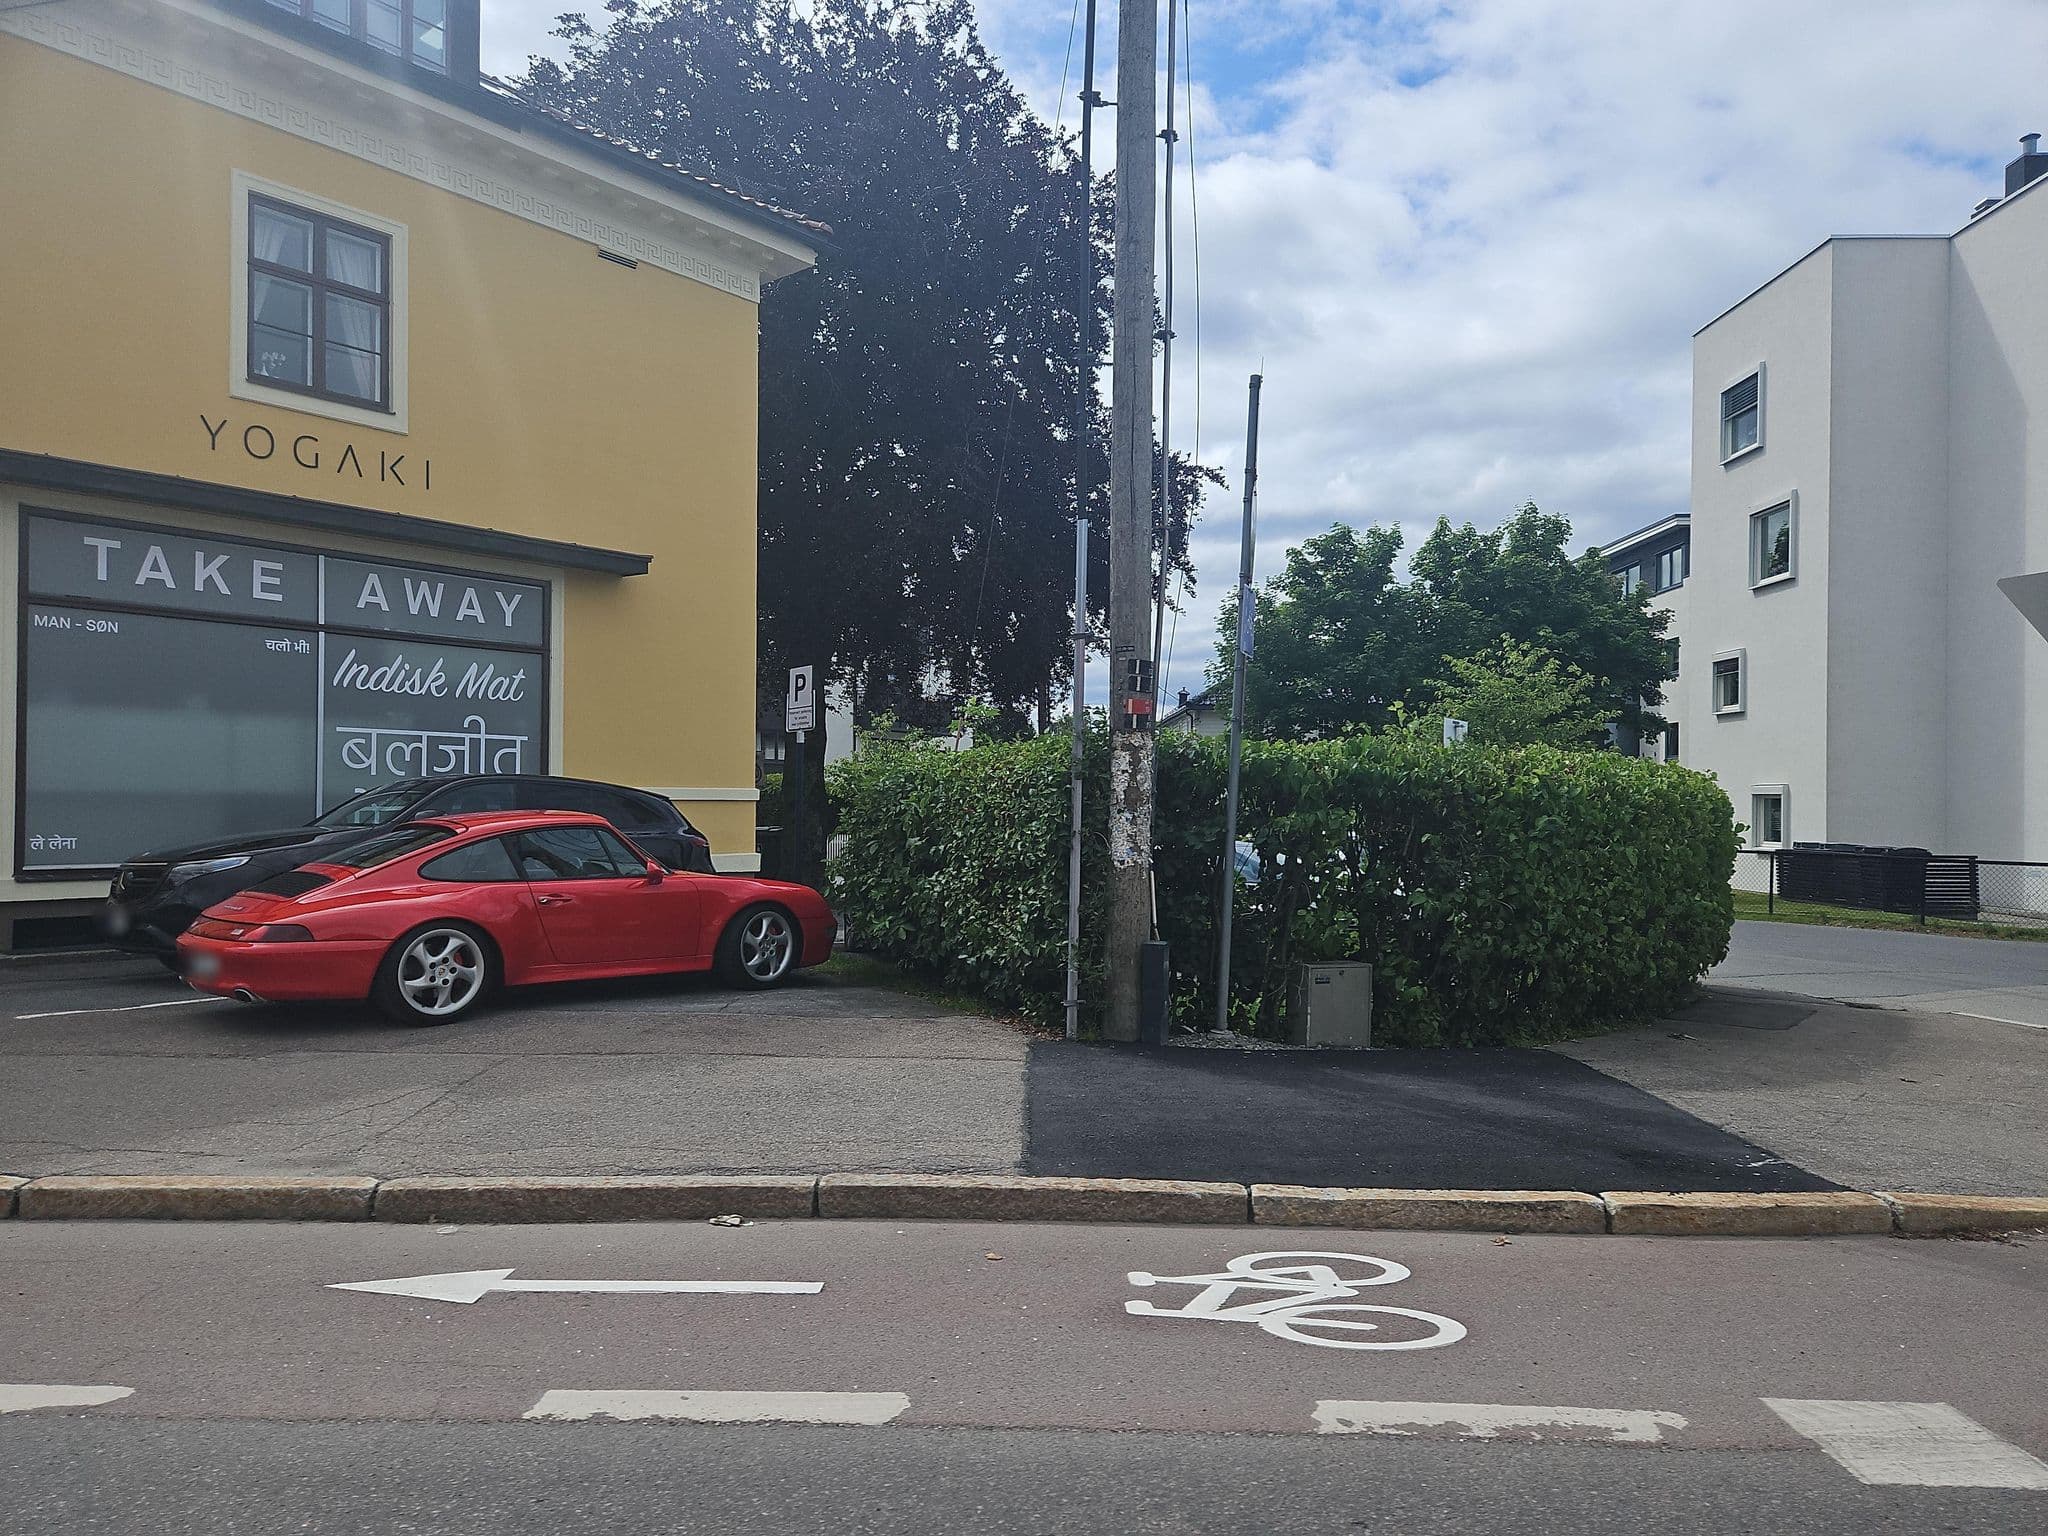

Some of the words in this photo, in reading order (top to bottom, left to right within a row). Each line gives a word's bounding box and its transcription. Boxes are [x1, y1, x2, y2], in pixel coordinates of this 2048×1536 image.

[200, 414, 430, 490] YOGAKI
[83, 536, 283, 602] TAKE
[356, 573, 522, 627] AWAY
[34, 614, 71, 629] MAN
[86, 619, 119, 633] SØN
[264, 638, 292, 652] चलो
[332, 649, 448, 697] Indisk
[455, 662, 526, 701] Mat
[794, 673, 807, 702] P
[336, 715, 528, 776] बलजीत
[30, 834, 45, 850] ले
[48, 834, 78, 850] लेना
